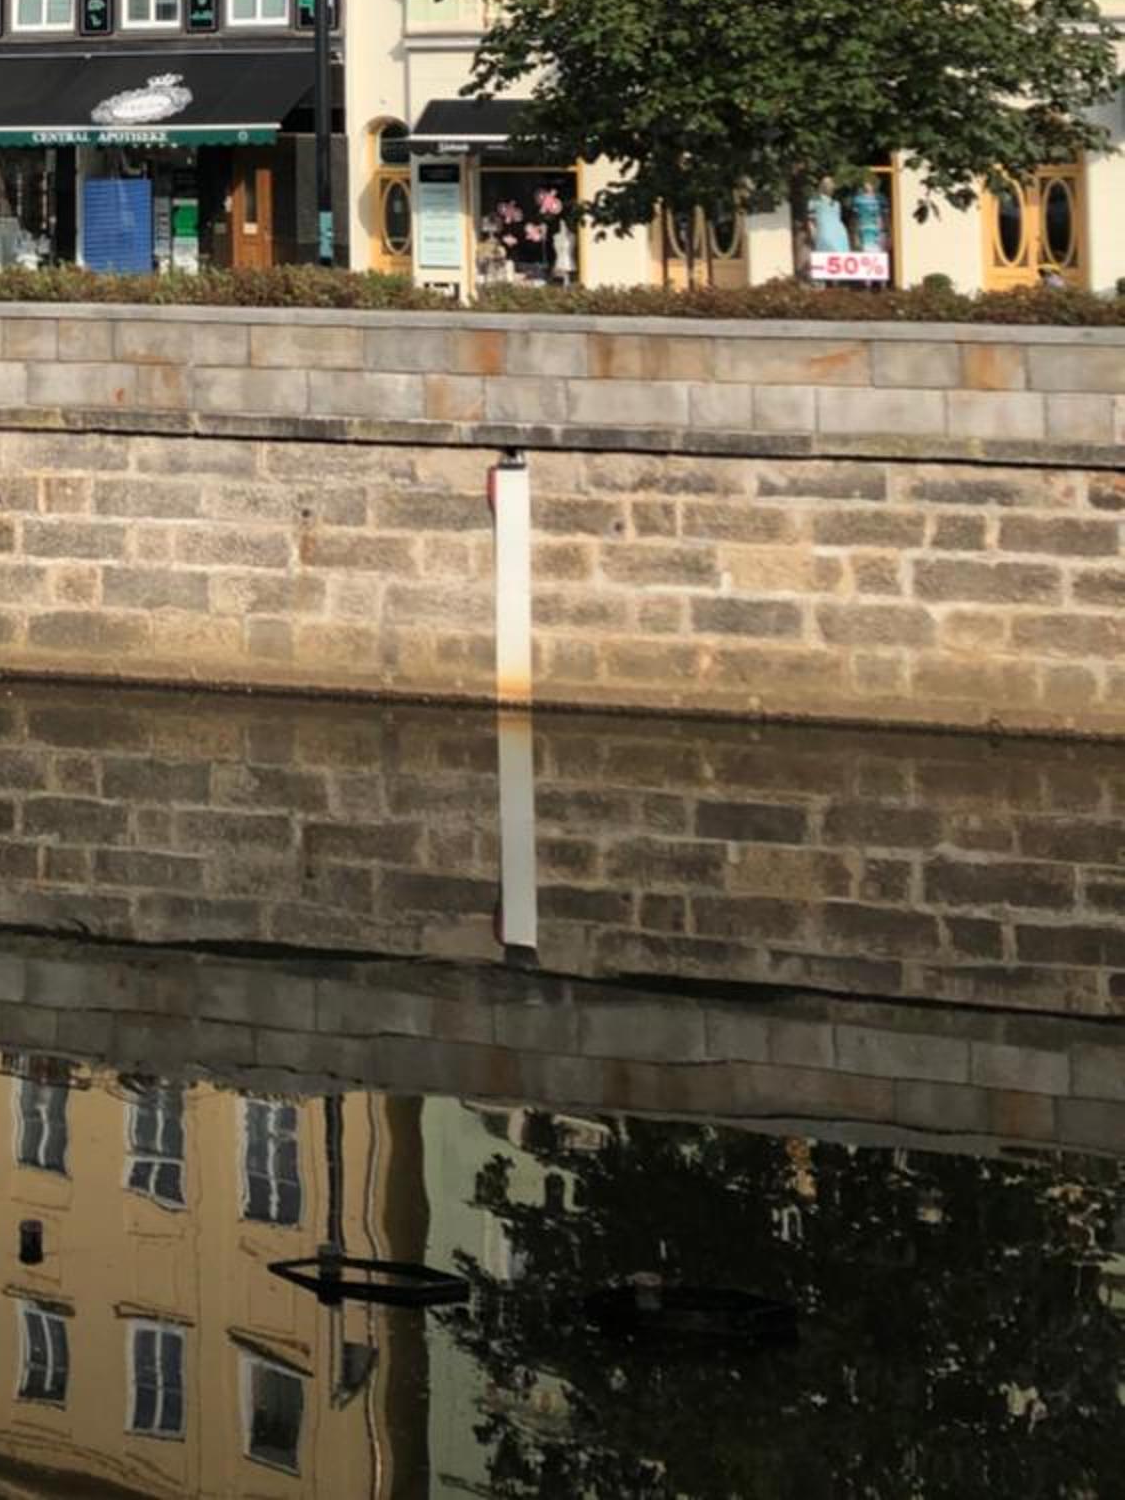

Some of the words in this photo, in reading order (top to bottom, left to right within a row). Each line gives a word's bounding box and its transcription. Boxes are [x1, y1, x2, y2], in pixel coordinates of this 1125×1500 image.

[32, 132, 91, 143] CENTRAL
[98, 131, 168, 143] APOTHEKE
[811, 256, 884, 275] -50%
